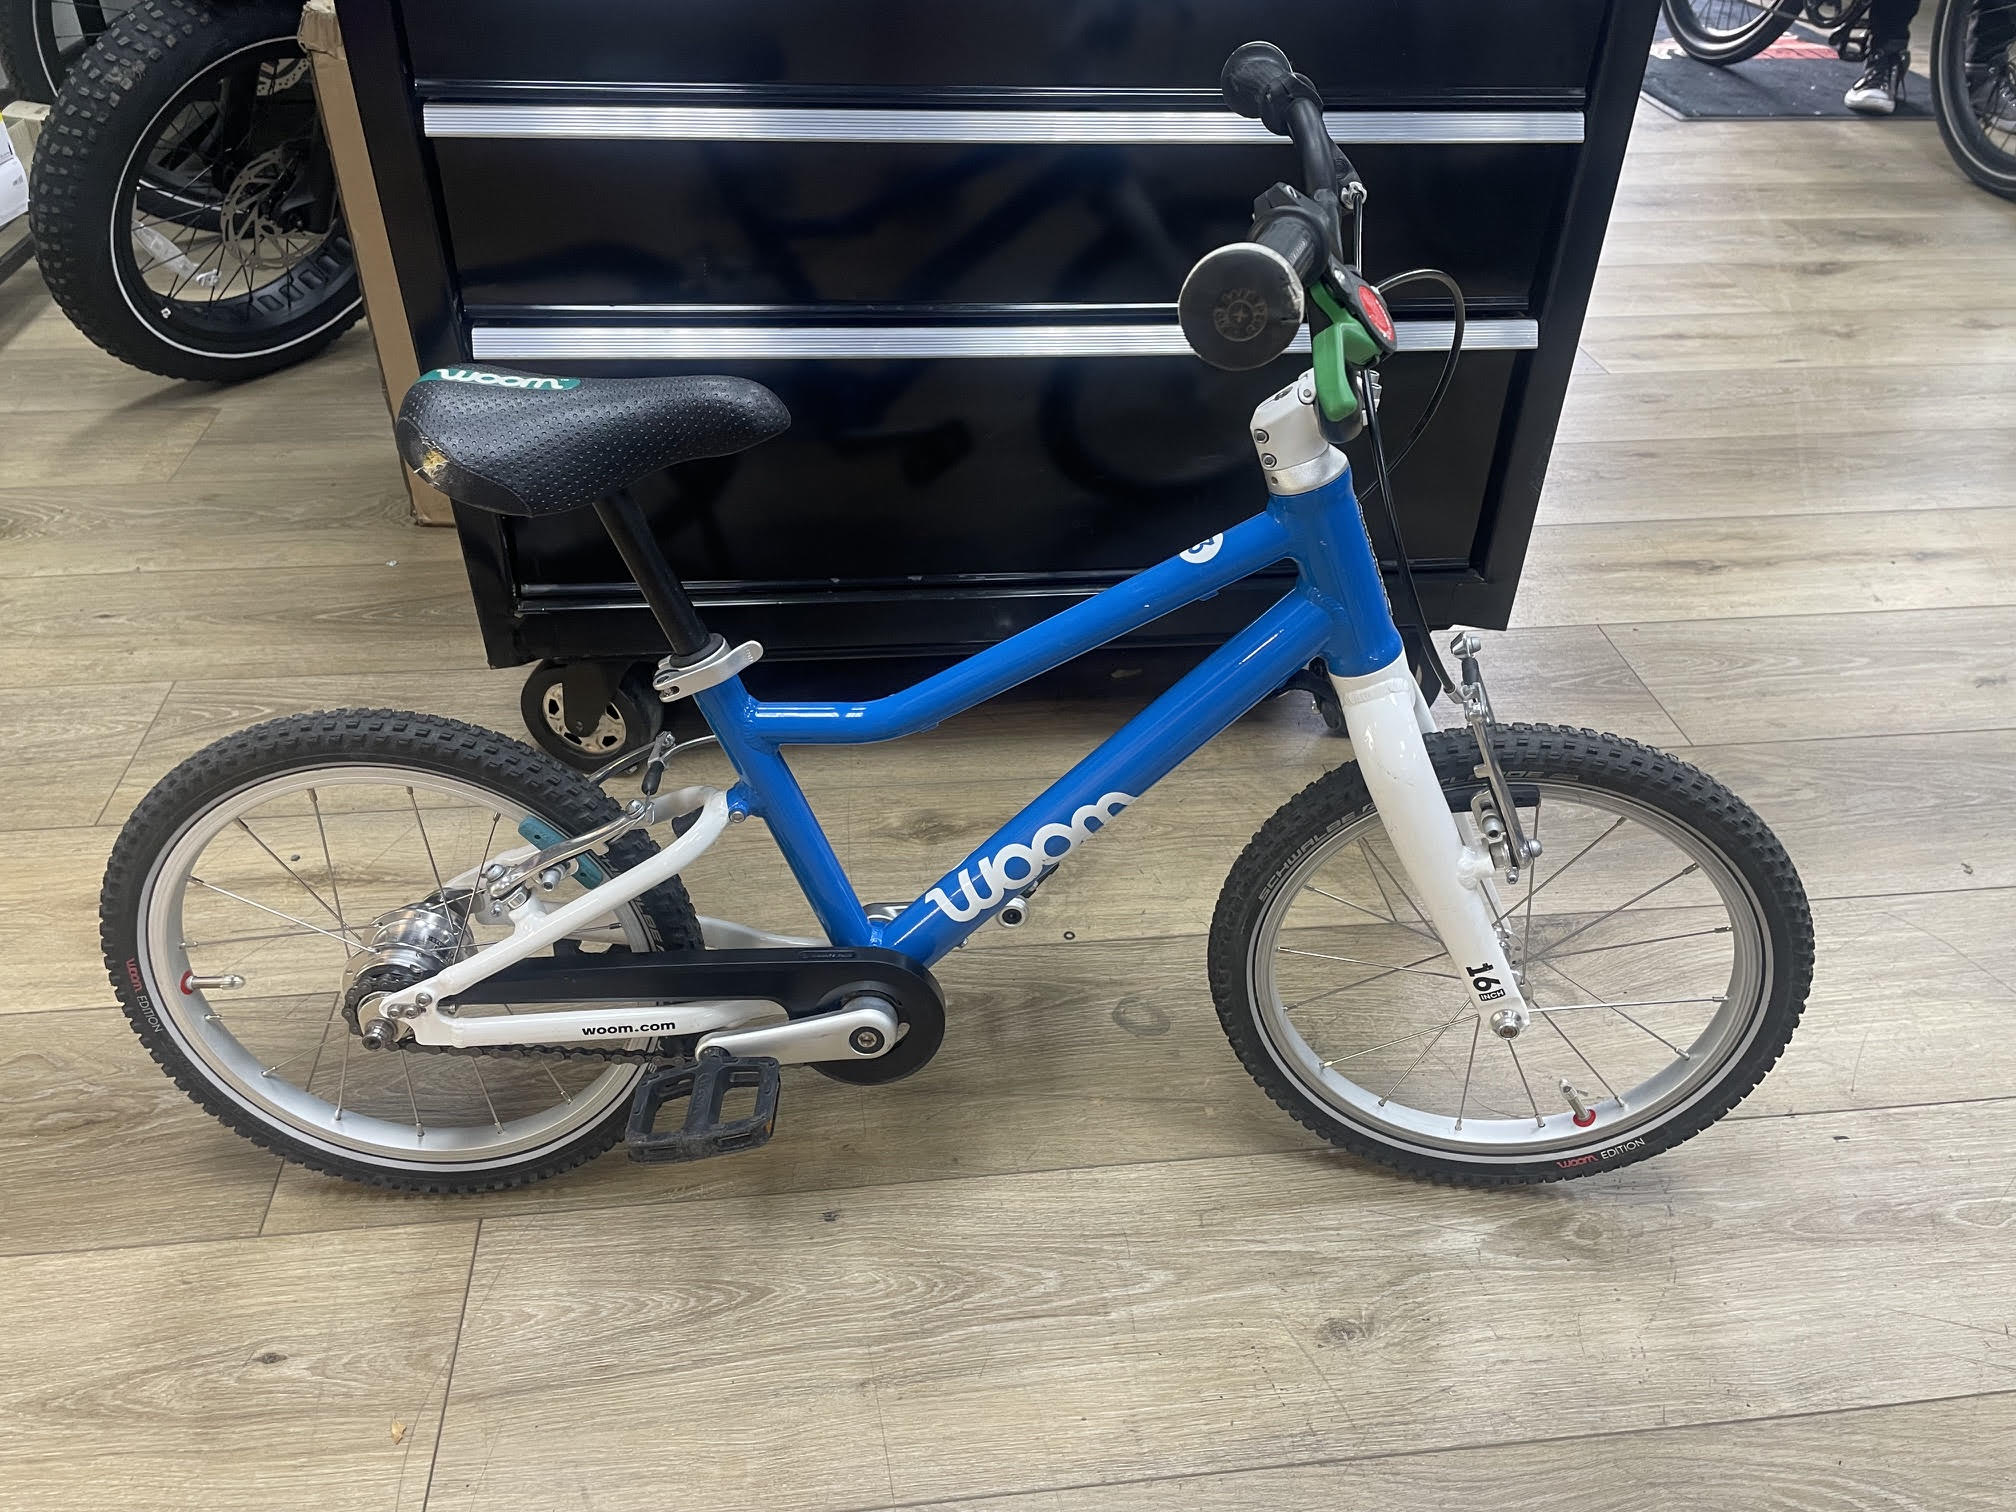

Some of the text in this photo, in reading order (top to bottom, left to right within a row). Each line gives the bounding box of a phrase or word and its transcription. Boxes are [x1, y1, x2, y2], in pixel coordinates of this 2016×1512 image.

[436, 368, 564, 390] woom
[924, 791, 1139, 922] woom
[1258, 811, 1356, 902] SCHWALBE
[1465, 962, 1502, 992] 16
[126, 957, 163, 1033] woom EDITION
[1480, 990, 1505, 1000] INCH
[582, 1022, 676, 1036] woom.com
[1556, 1138, 1645, 1169] woom EDITION
